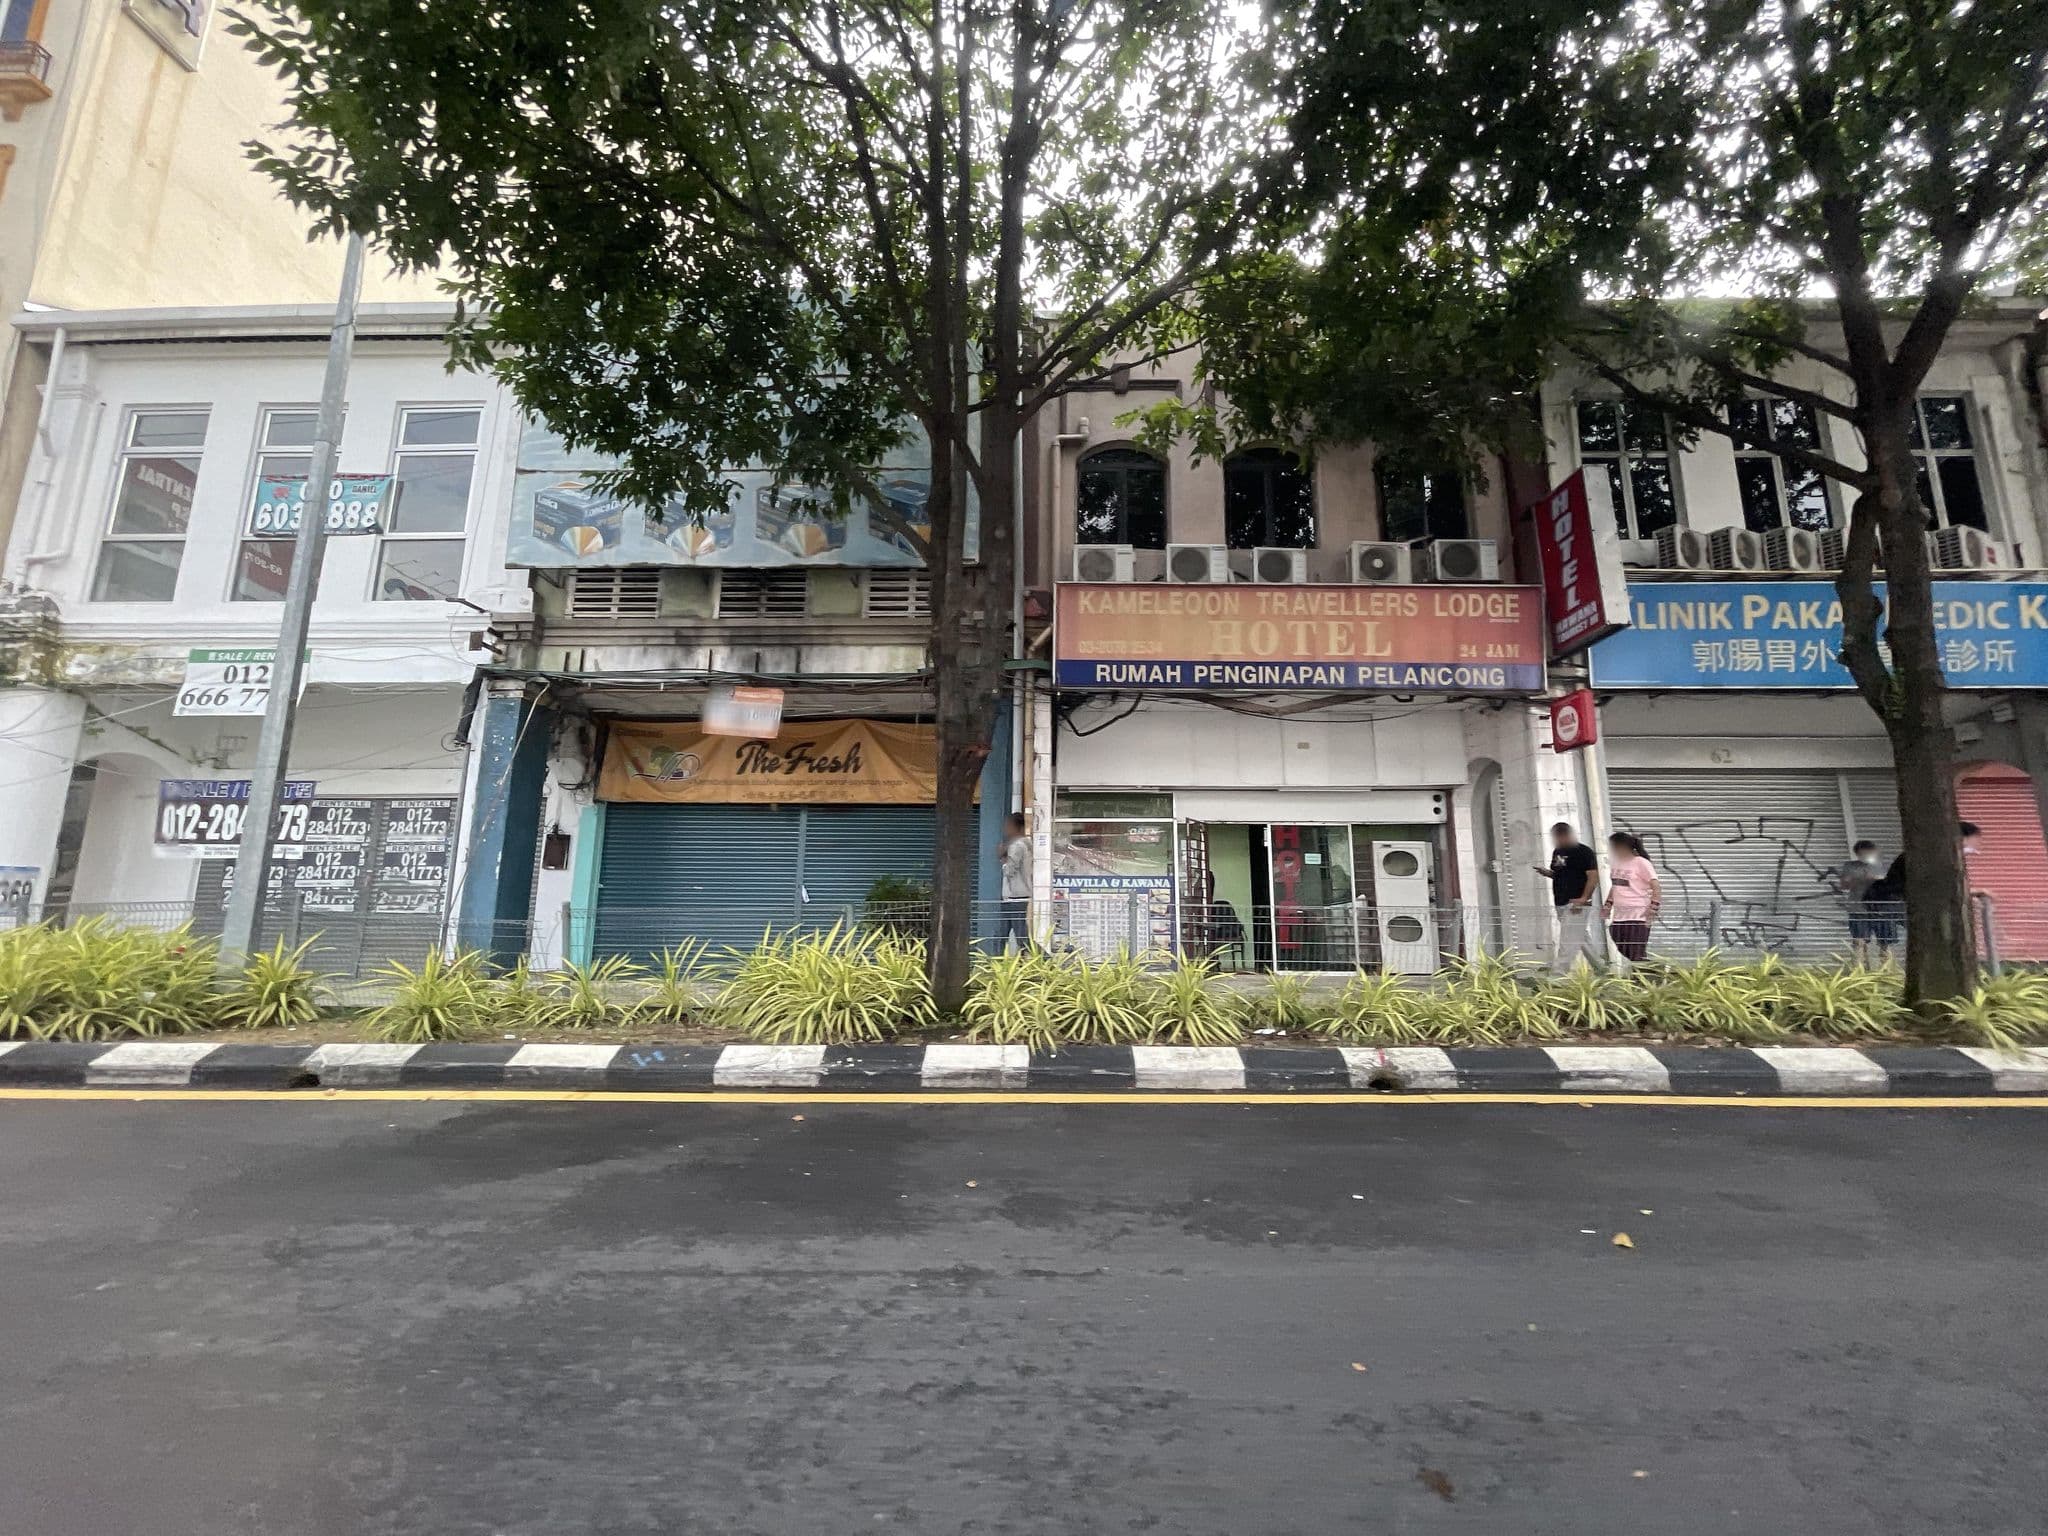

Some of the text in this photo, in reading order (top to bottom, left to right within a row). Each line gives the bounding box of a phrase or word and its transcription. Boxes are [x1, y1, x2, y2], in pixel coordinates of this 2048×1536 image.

[1551, 487, 1581, 611] HOTEL
[1256, 592, 1418, 617] TRAVELLERS
[1434, 593, 1520, 618] LODGE
[1629, 596, 1734, 630] LINIK
[1743, 595, 1844, 630] PAKA
[1884, 597, 2010, 630] EDIC
[1207, 620, 1392, 657] HOTEL
[216, 652, 242, 661] SALE
[254, 652, 277, 661] REN
[1459, 643, 1520, 659] 24 JAM
[1692, 638, 2017, 674] 郭腸胃外診所
[223, 664, 270, 685] 012
[1096, 664, 1506, 687] RUMAH PENGINAPAN PELANCONG
[180, 687, 233, 706] 666
[736, 740, 861, 775] The Fresh
[1711, 749, 1731, 764] 62
[326, 808, 353, 821] 012
[406, 808, 432, 821] 012
[307, 821, 367, 835] 2841773
[389, 821, 447, 835] 2841773
[315, 853, 342, 866] 012
[401, 853, 427, 866] 012
[296, 866, 356, 880] 2841773
[1110, 878, 1120, 888] &
[1122, 878, 1171, 888] KAWANA
